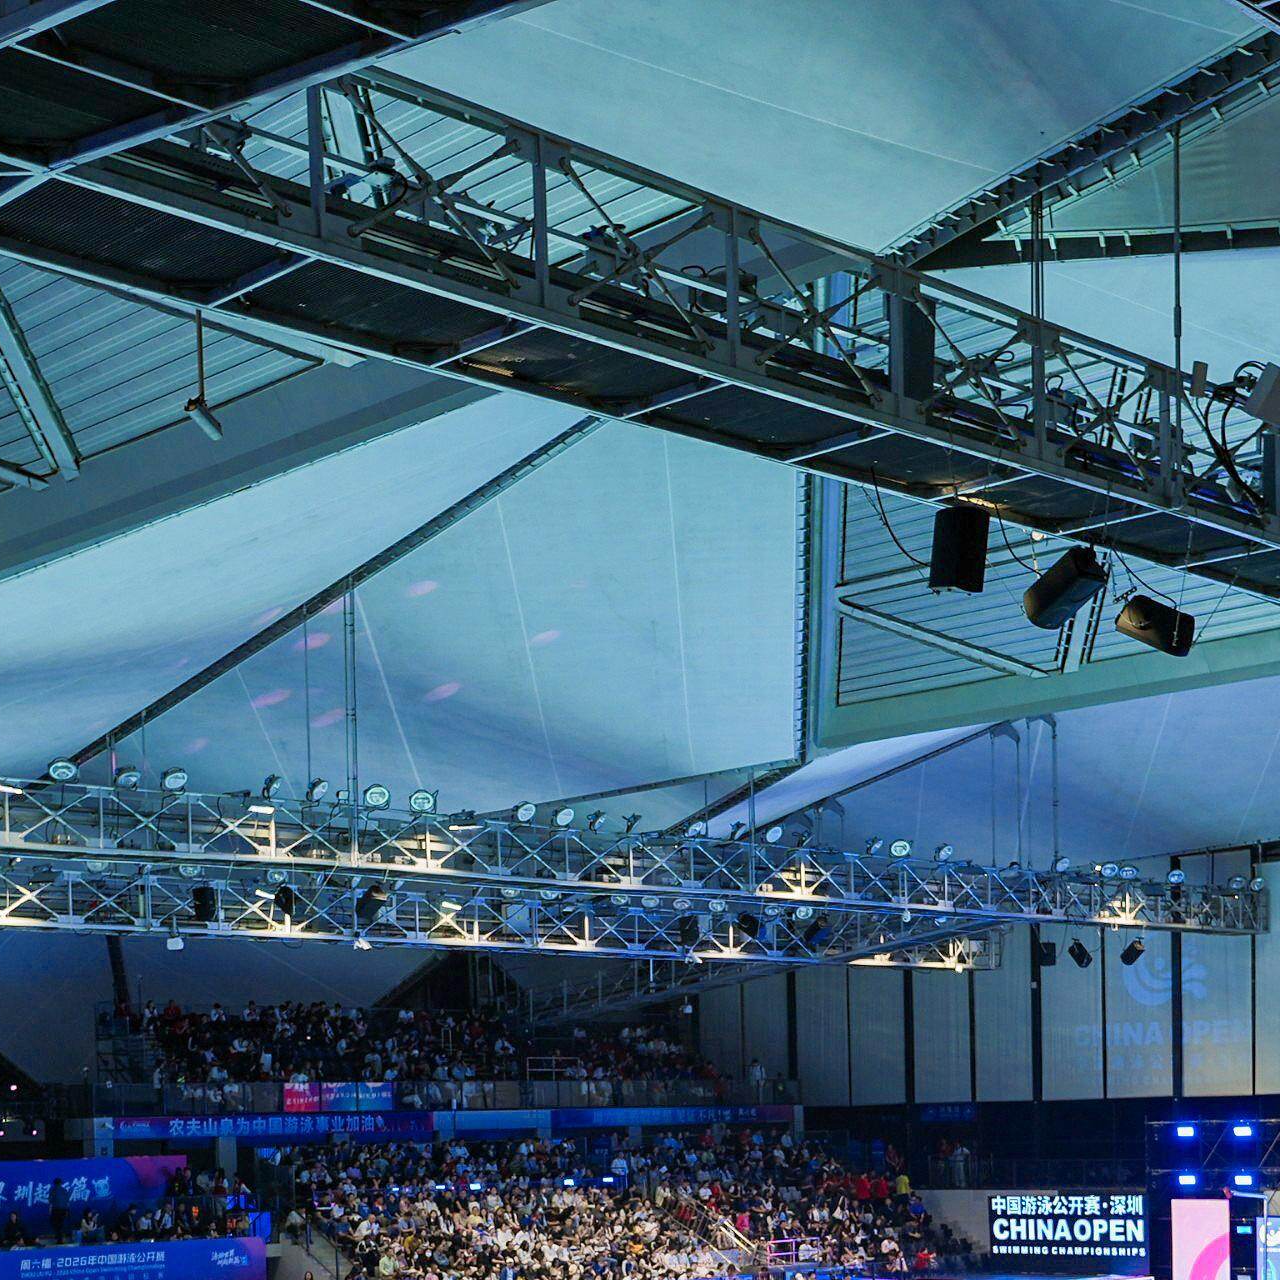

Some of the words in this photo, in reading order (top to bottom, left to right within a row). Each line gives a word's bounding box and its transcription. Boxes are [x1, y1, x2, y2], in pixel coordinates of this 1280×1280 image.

[14, 1176, 91, 1207] 圳起篇
[991, 1194, 1144, 1216] 中国游泳公开赛·深圳
[992, 1218, 1071, 1242] CHINA
[1071, 1219, 1145, 1243] OPEN
[992, 1245, 1049, 1255] SWIMMING
[1052, 1246, 1147, 1257] CHAMPIONSHIPS
